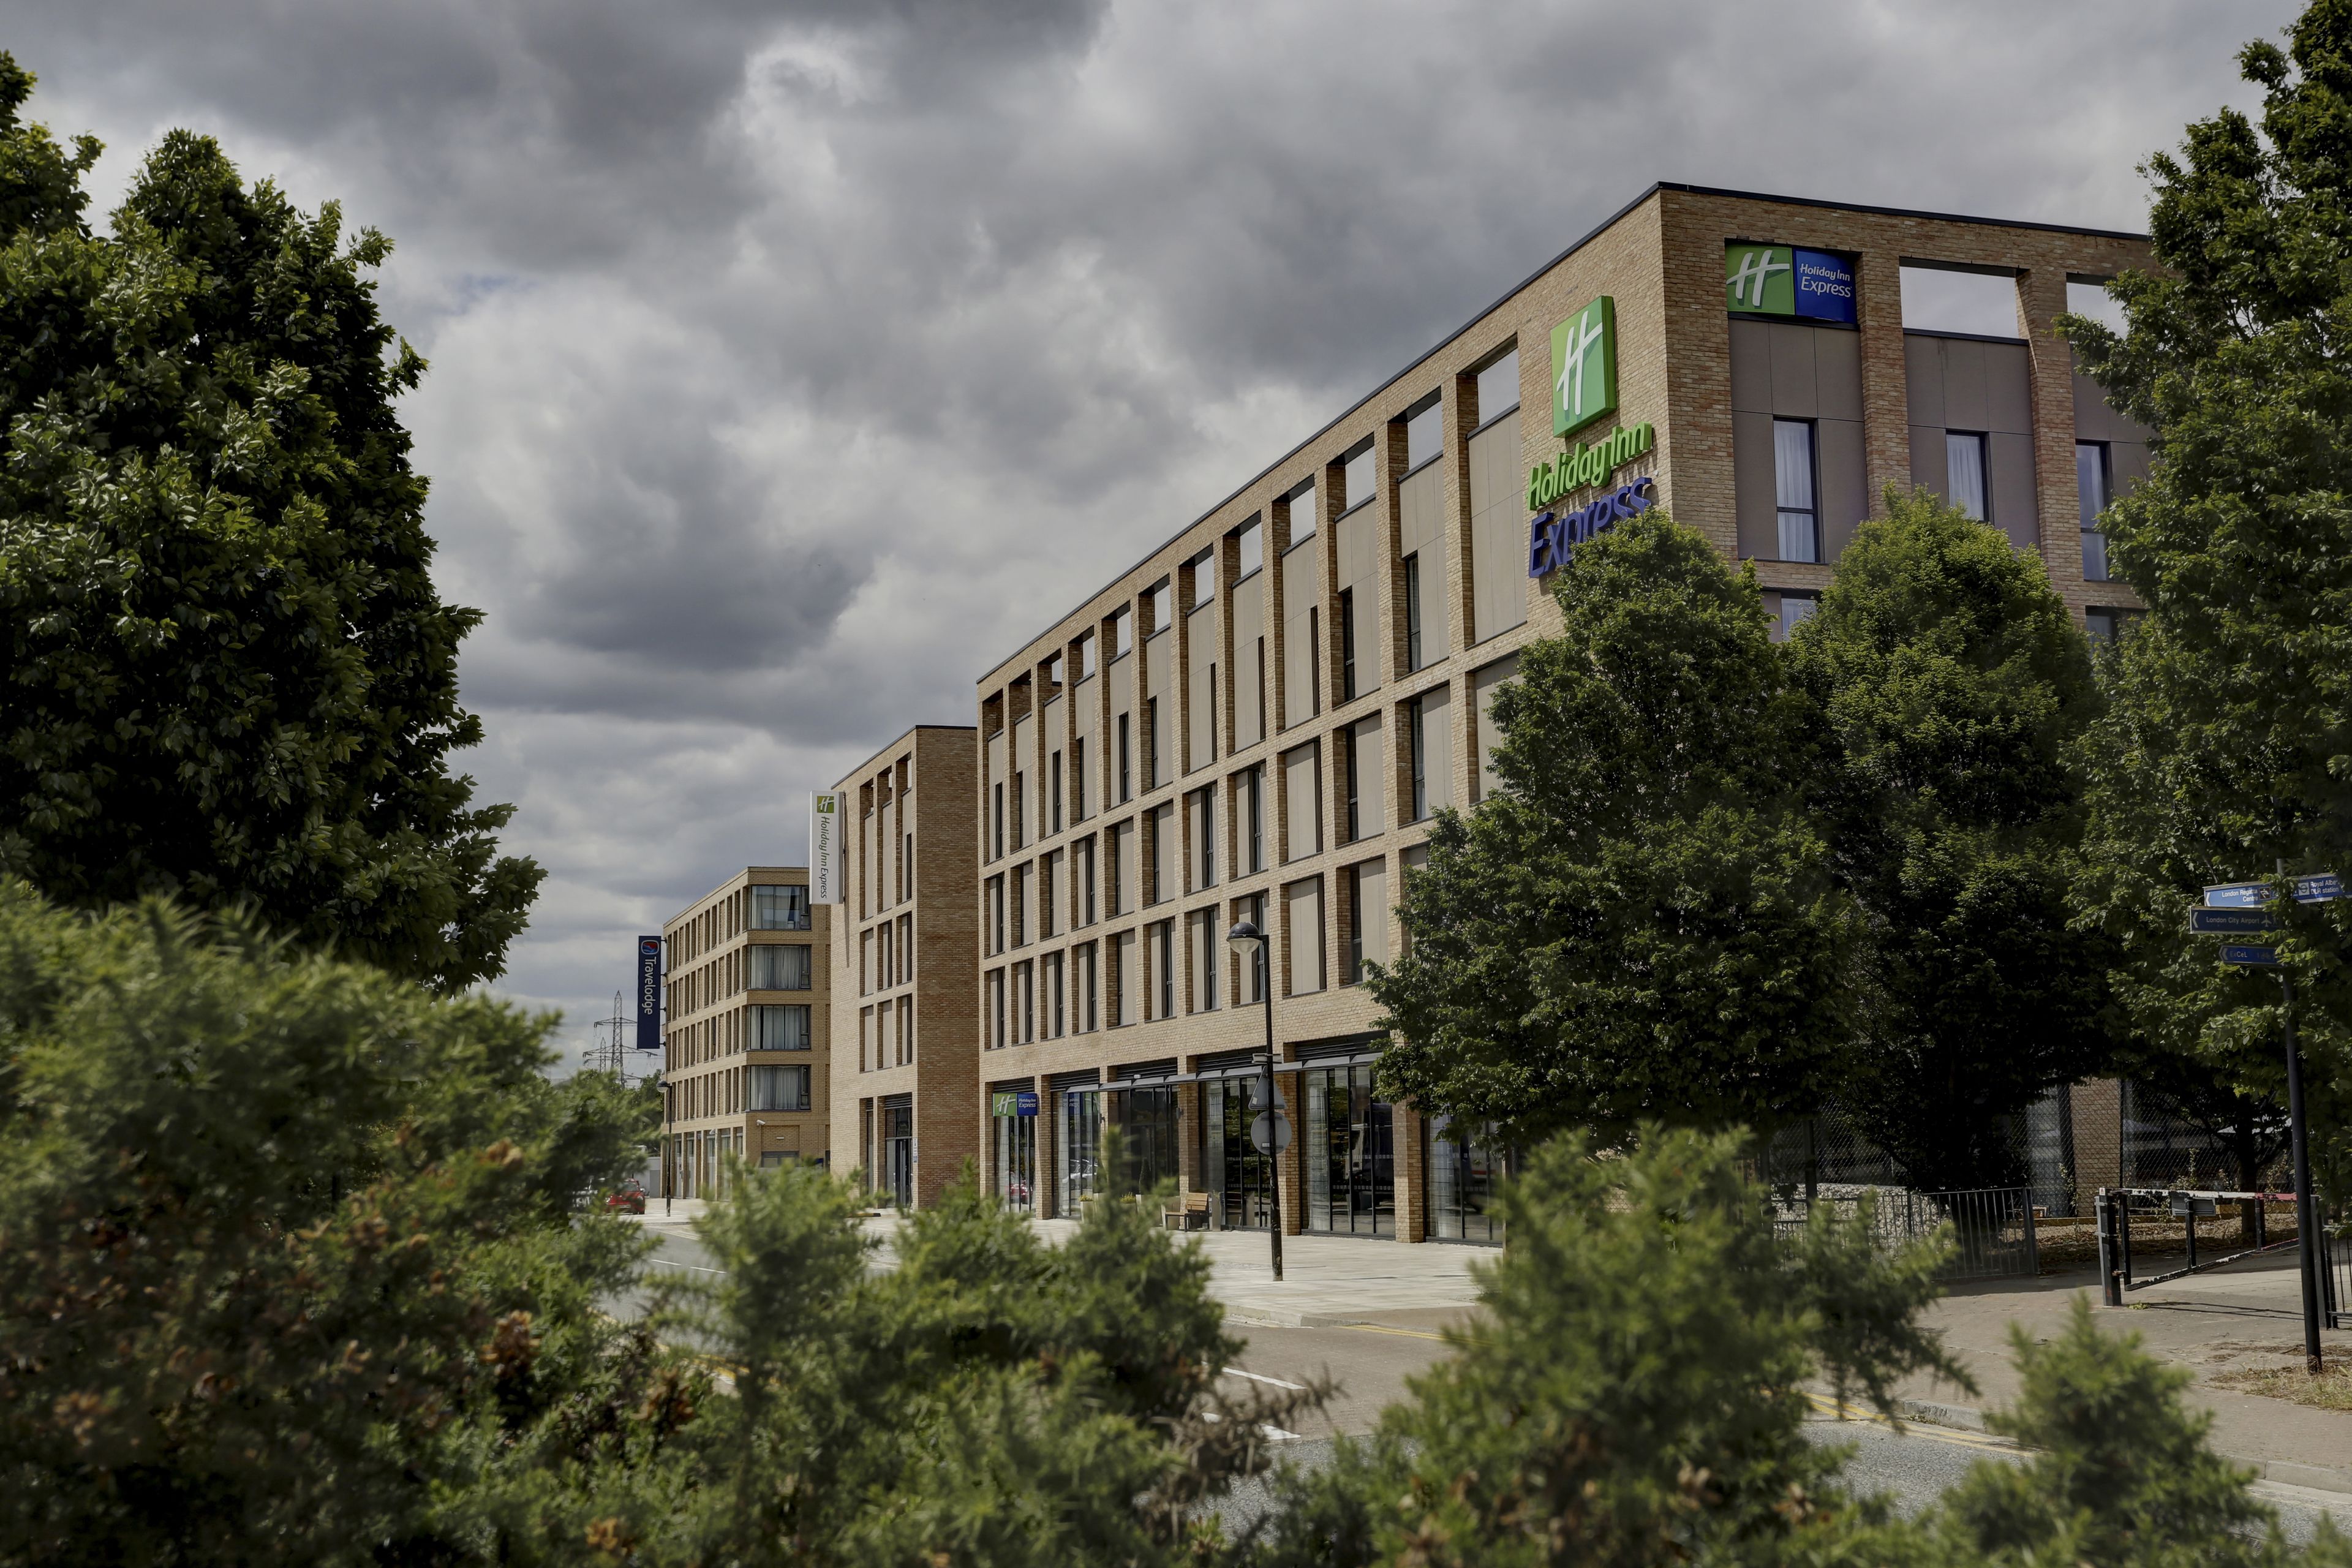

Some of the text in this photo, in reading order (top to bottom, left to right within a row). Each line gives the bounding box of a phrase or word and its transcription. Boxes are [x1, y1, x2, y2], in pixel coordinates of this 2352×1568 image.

[1800, 263, 1850, 282] Holiday Inn
[1801, 276, 1852, 298] Express
[1526, 421, 1653, 511] Holiday Inn
[1528, 477, 1653, 578] Express
[819, 816, 830, 899] Holiday Inn Express
[642, 956, 657, 1015] Travelodge
